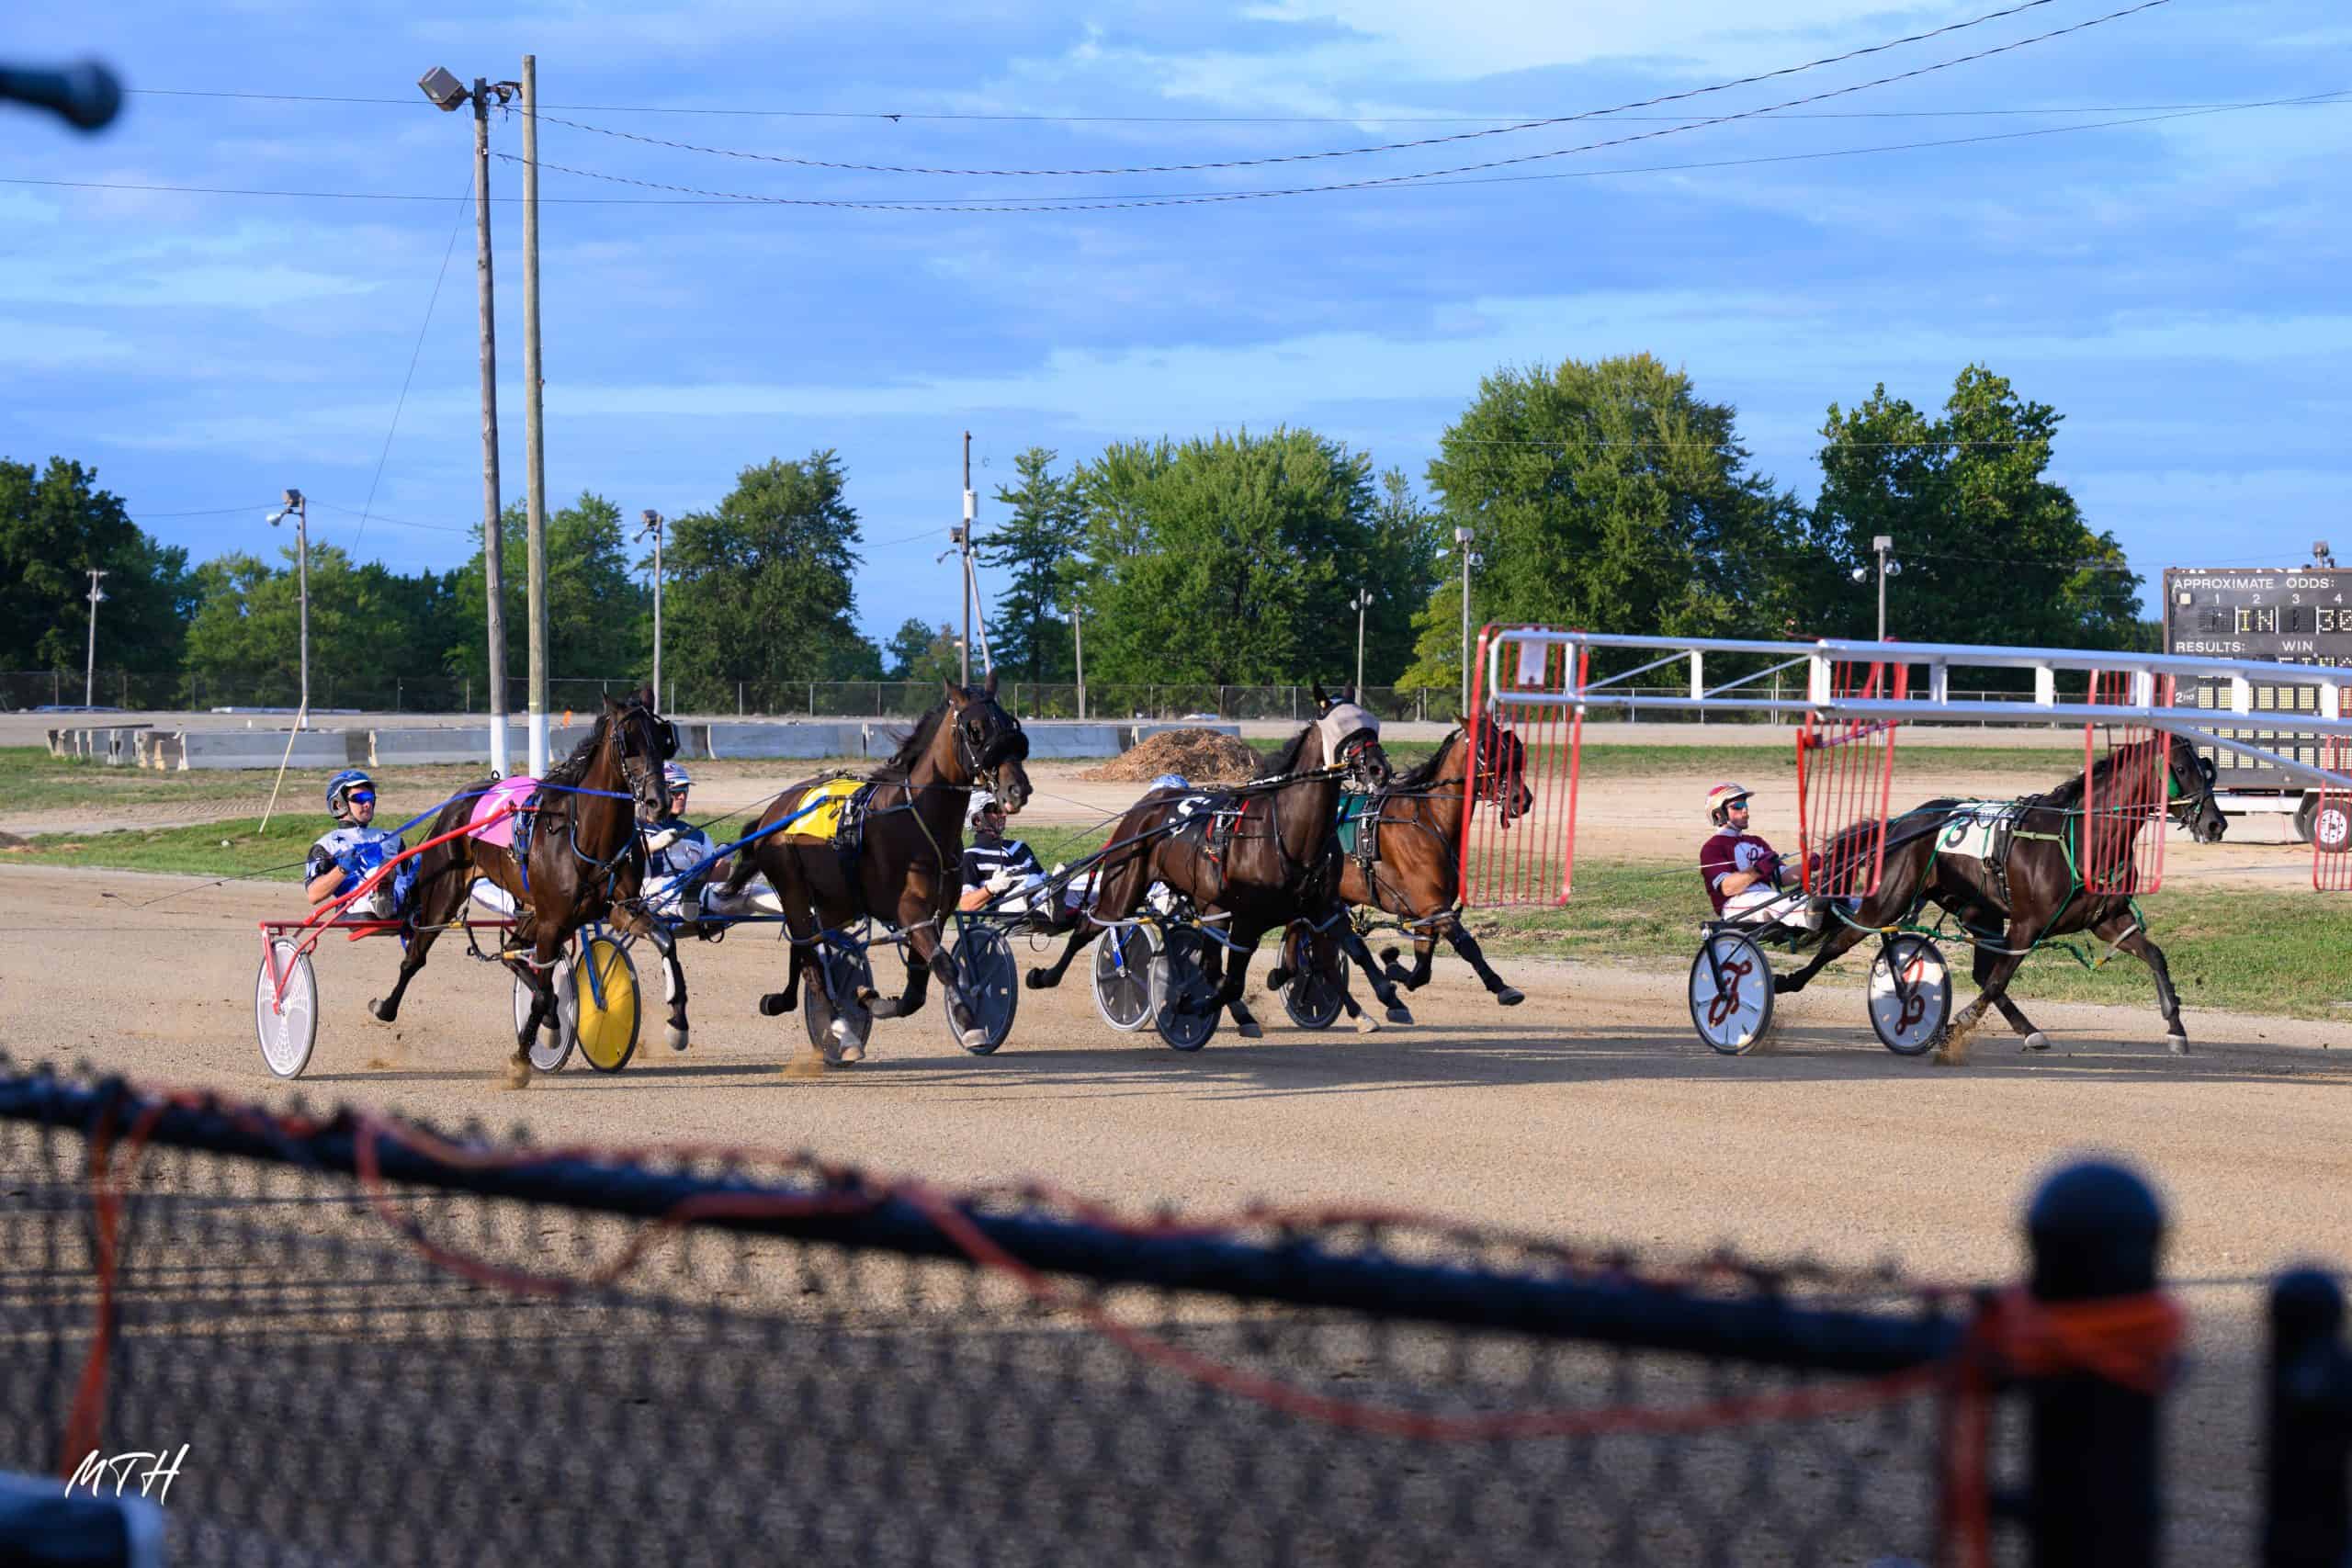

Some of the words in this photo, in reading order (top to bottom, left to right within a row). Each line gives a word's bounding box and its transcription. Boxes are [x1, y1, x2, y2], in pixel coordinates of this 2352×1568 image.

[2174, 578, 2274, 589] APPROXIMATE
[2286, 577, 2335, 589] ODDS:
[2214, 593, 2220, 604] 1
[2253, 593, 2261, 604] 2
[2292, 593, 2301, 604] 3
[2335, 593, 2343, 604] 4
[2238, 609, 2274, 632] IN
[2176, 641, 2246, 653] RESULTS:
[2282, 640, 2313, 652] WIN
[2176, 692, 2195, 703] 2nd
